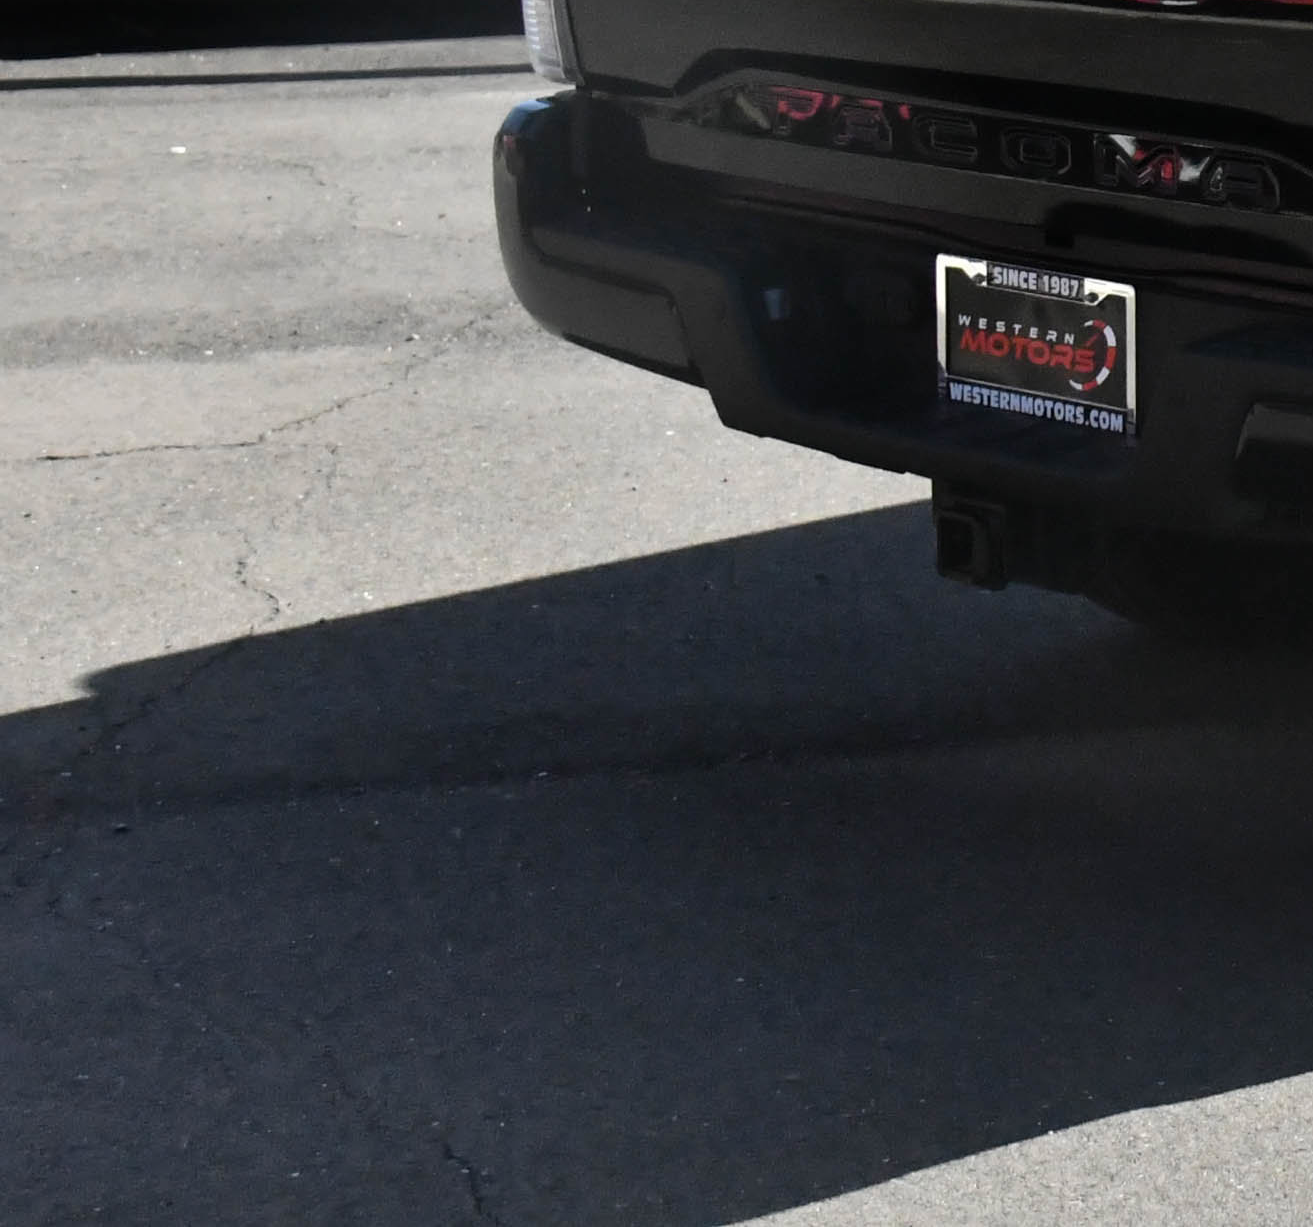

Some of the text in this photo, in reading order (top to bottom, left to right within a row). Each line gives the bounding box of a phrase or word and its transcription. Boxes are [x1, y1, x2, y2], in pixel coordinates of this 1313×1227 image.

[992, 266, 1082, 298] SINCE 1987
[957, 313, 1077, 346] WESTERN
[959, 328, 1096, 375] MOTORS
[949, 381, 1125, 433] WESTERNMOTORS.COM
